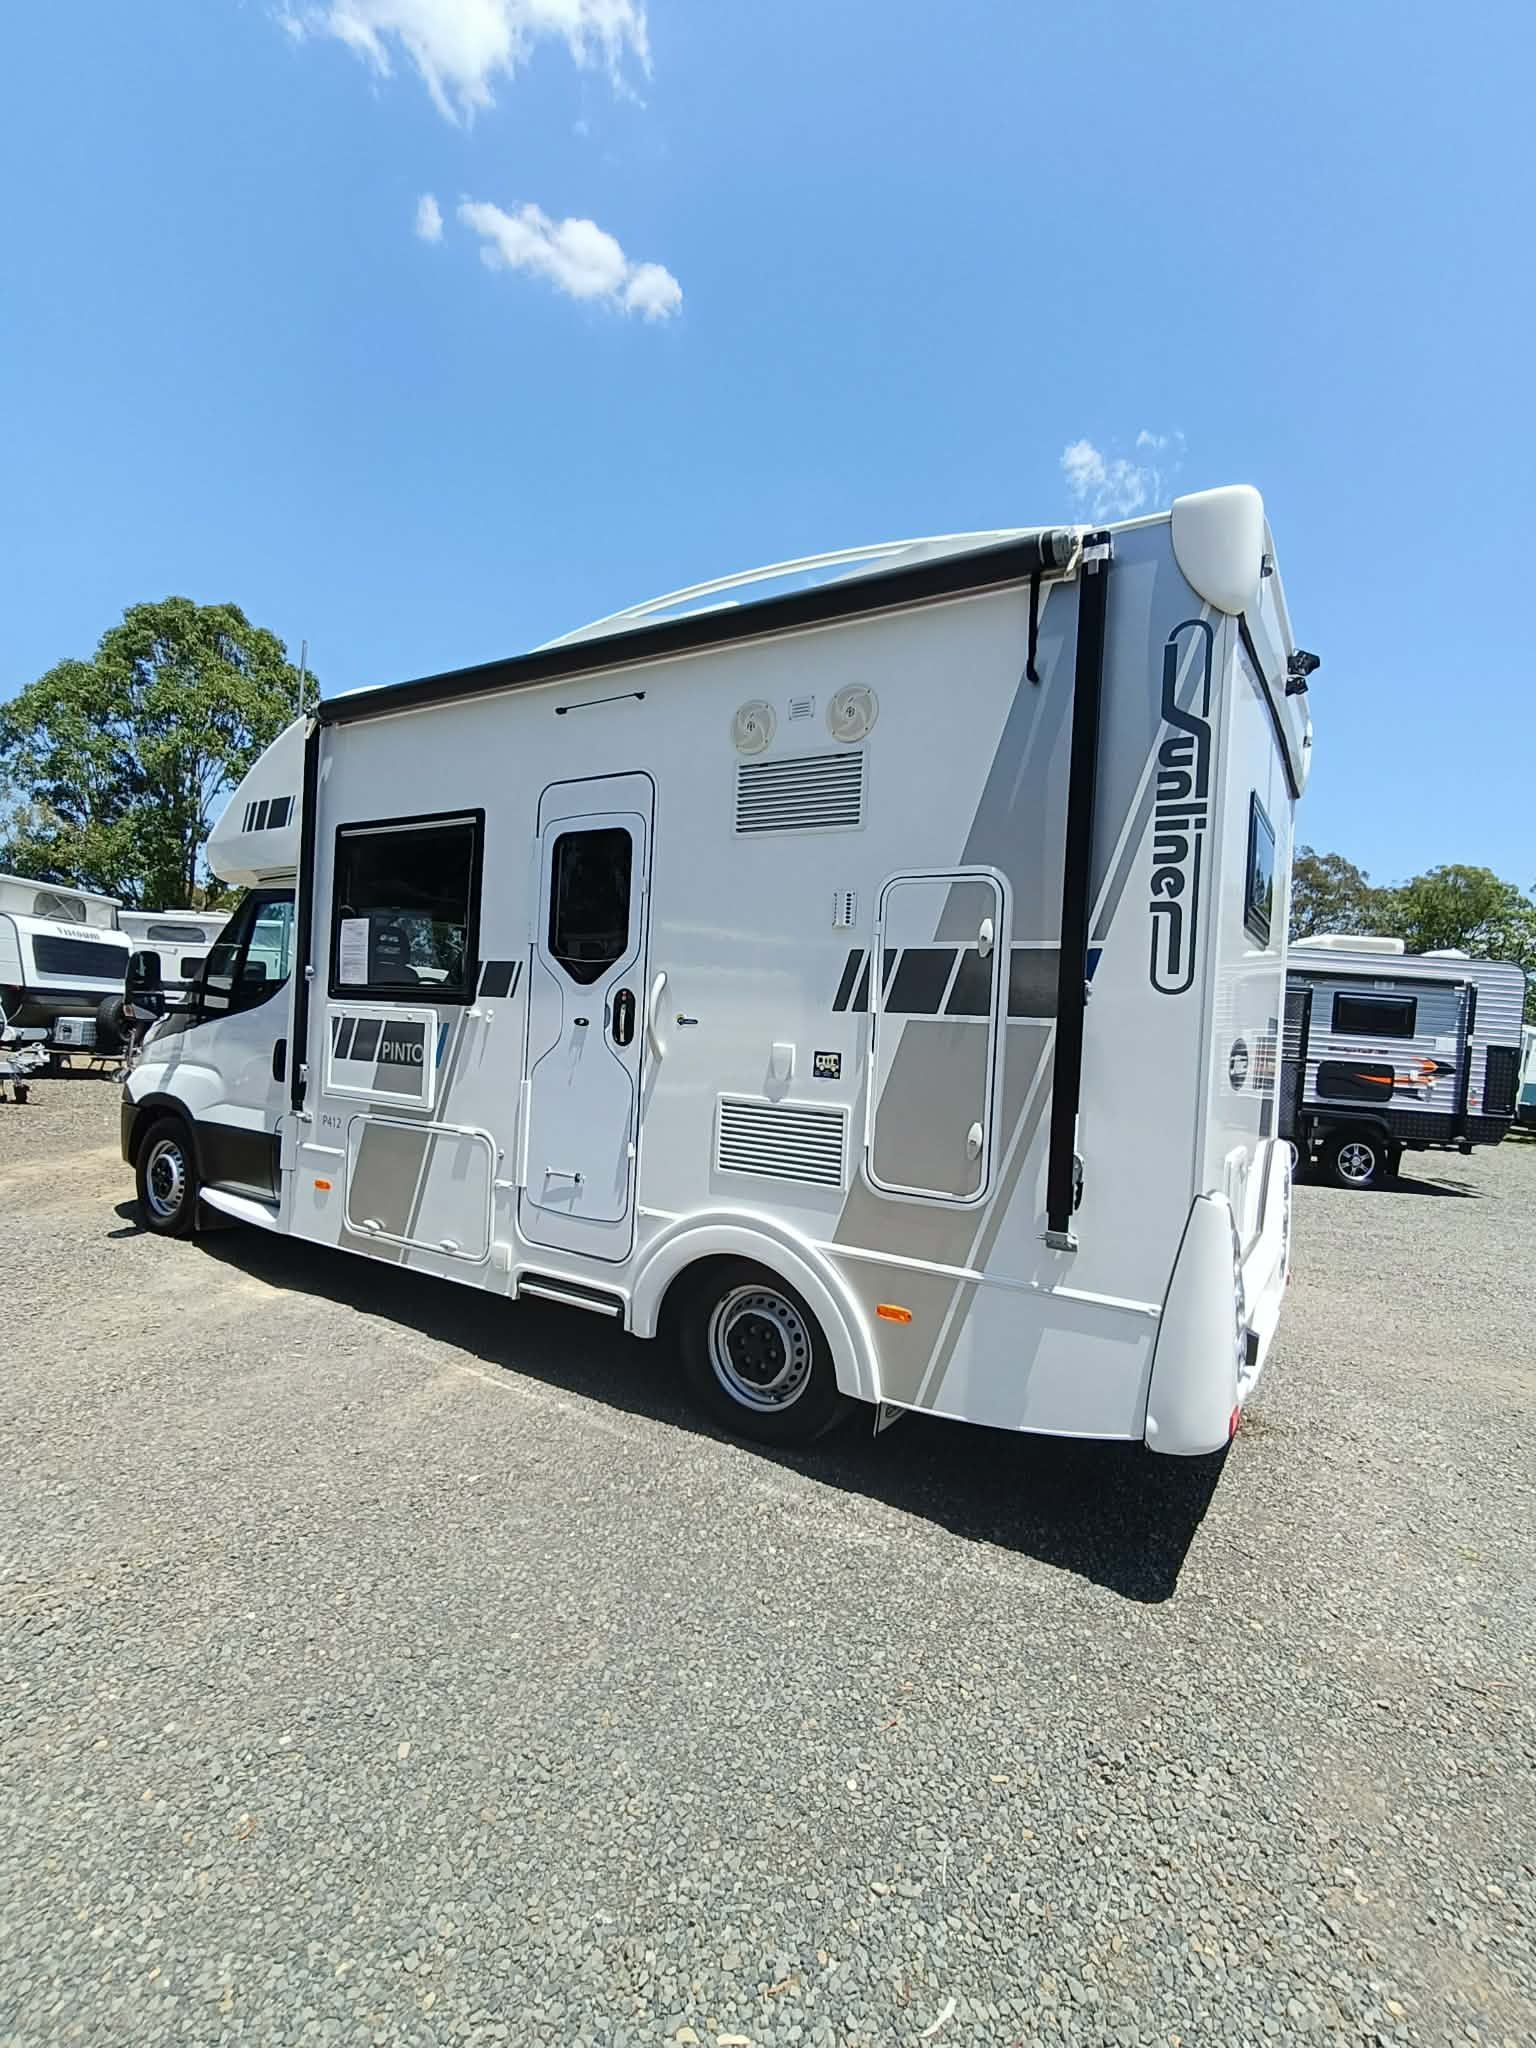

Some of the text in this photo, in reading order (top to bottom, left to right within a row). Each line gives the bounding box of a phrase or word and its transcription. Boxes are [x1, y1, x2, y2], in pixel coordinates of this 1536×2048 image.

[1149, 619, 1214, 995] Sunliner
[382, 1041, 424, 1063] PINTO
[322, 1114, 342, 1129] P412
